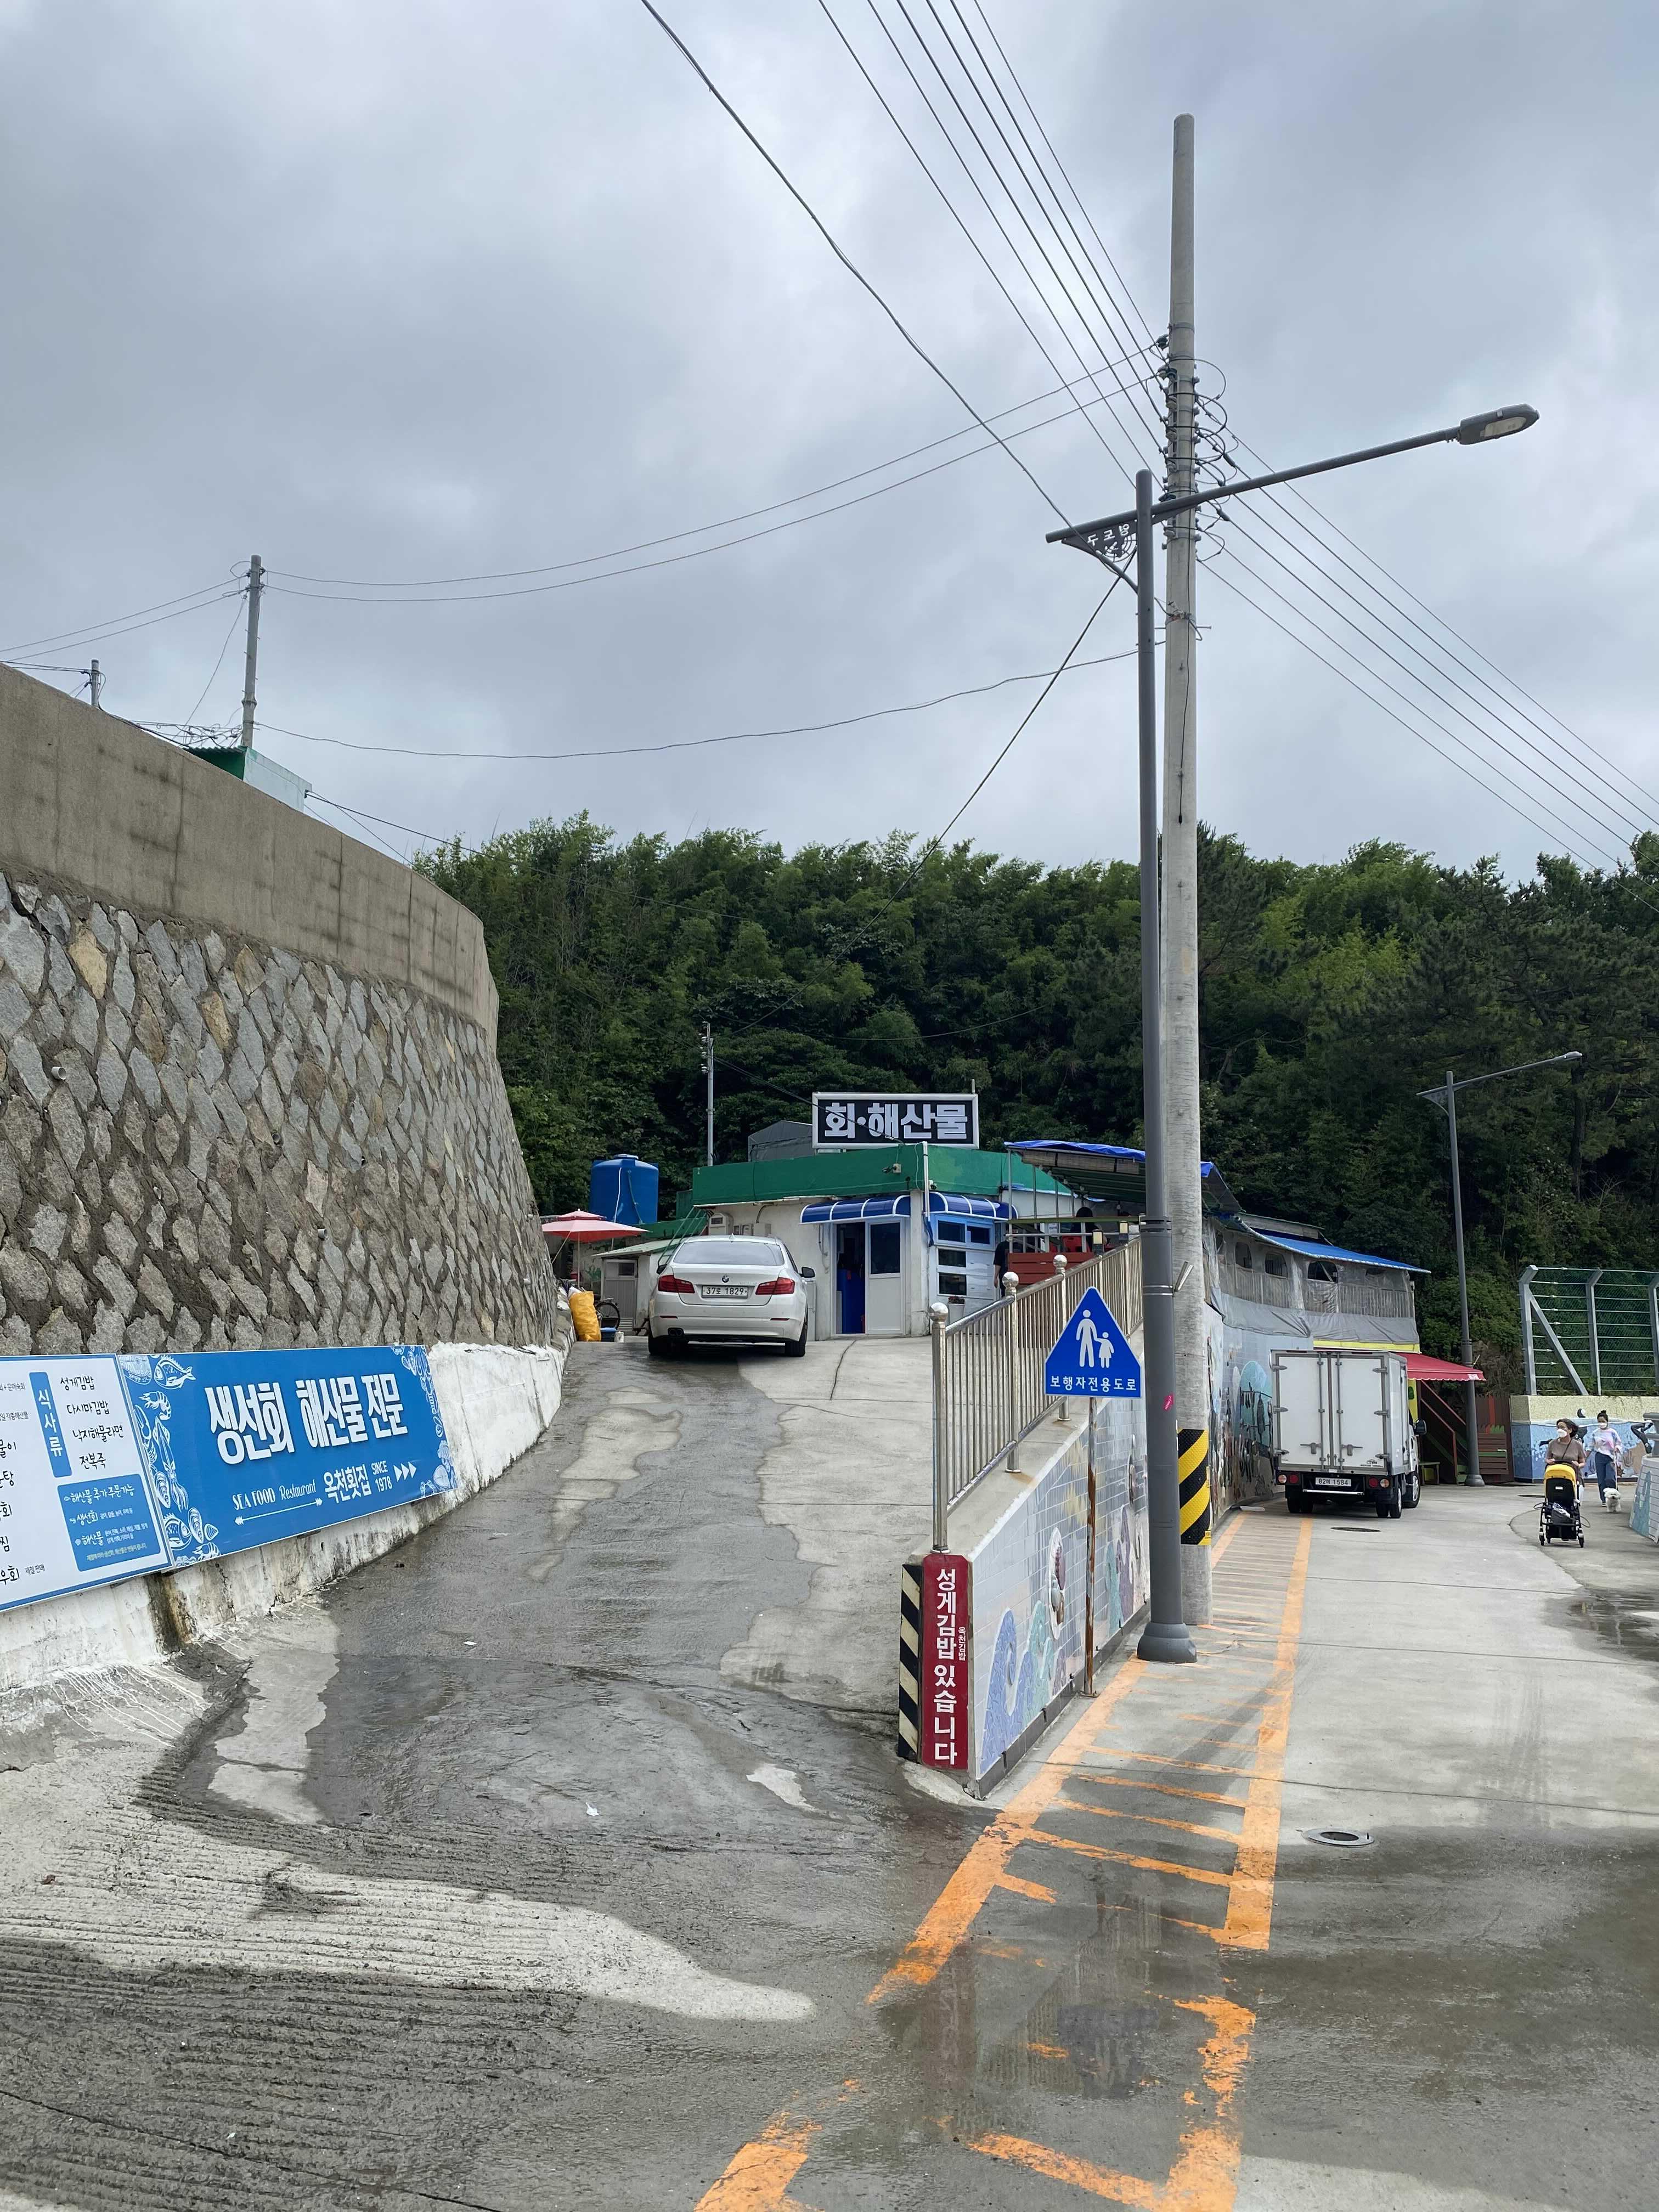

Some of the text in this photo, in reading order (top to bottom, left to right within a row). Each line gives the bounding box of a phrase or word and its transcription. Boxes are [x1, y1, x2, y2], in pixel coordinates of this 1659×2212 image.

[60, 1375, 95, 1391] 성게김밥
[1050, 1375, 1137, 1392] 보행자전용도로
[66, 1400, 110, 1415] 다시마김밥
[38, 1389, 63, 1457] 식사류
[204, 1373, 408, 1465] 생선회 해산물 전문
[72, 1424, 124, 1443] 낙지해물라면
[79, 1452, 106, 1470] 전복죽
[371, 1460, 388, 1475] SINCE
[323, 1464, 372, 1504] 옥천횟집
[375, 1476, 393, 1492] 1978
[70, 1489, 93, 1504] 해산물
[232, 1480, 317, 1511] SEA FOOD Restaurant
[76, 1510, 99, 1526] 생선회
[81, 1531, 104, 1546] 해산물
[933, 1568, 958, 1765] 성게김밥 있습니다
